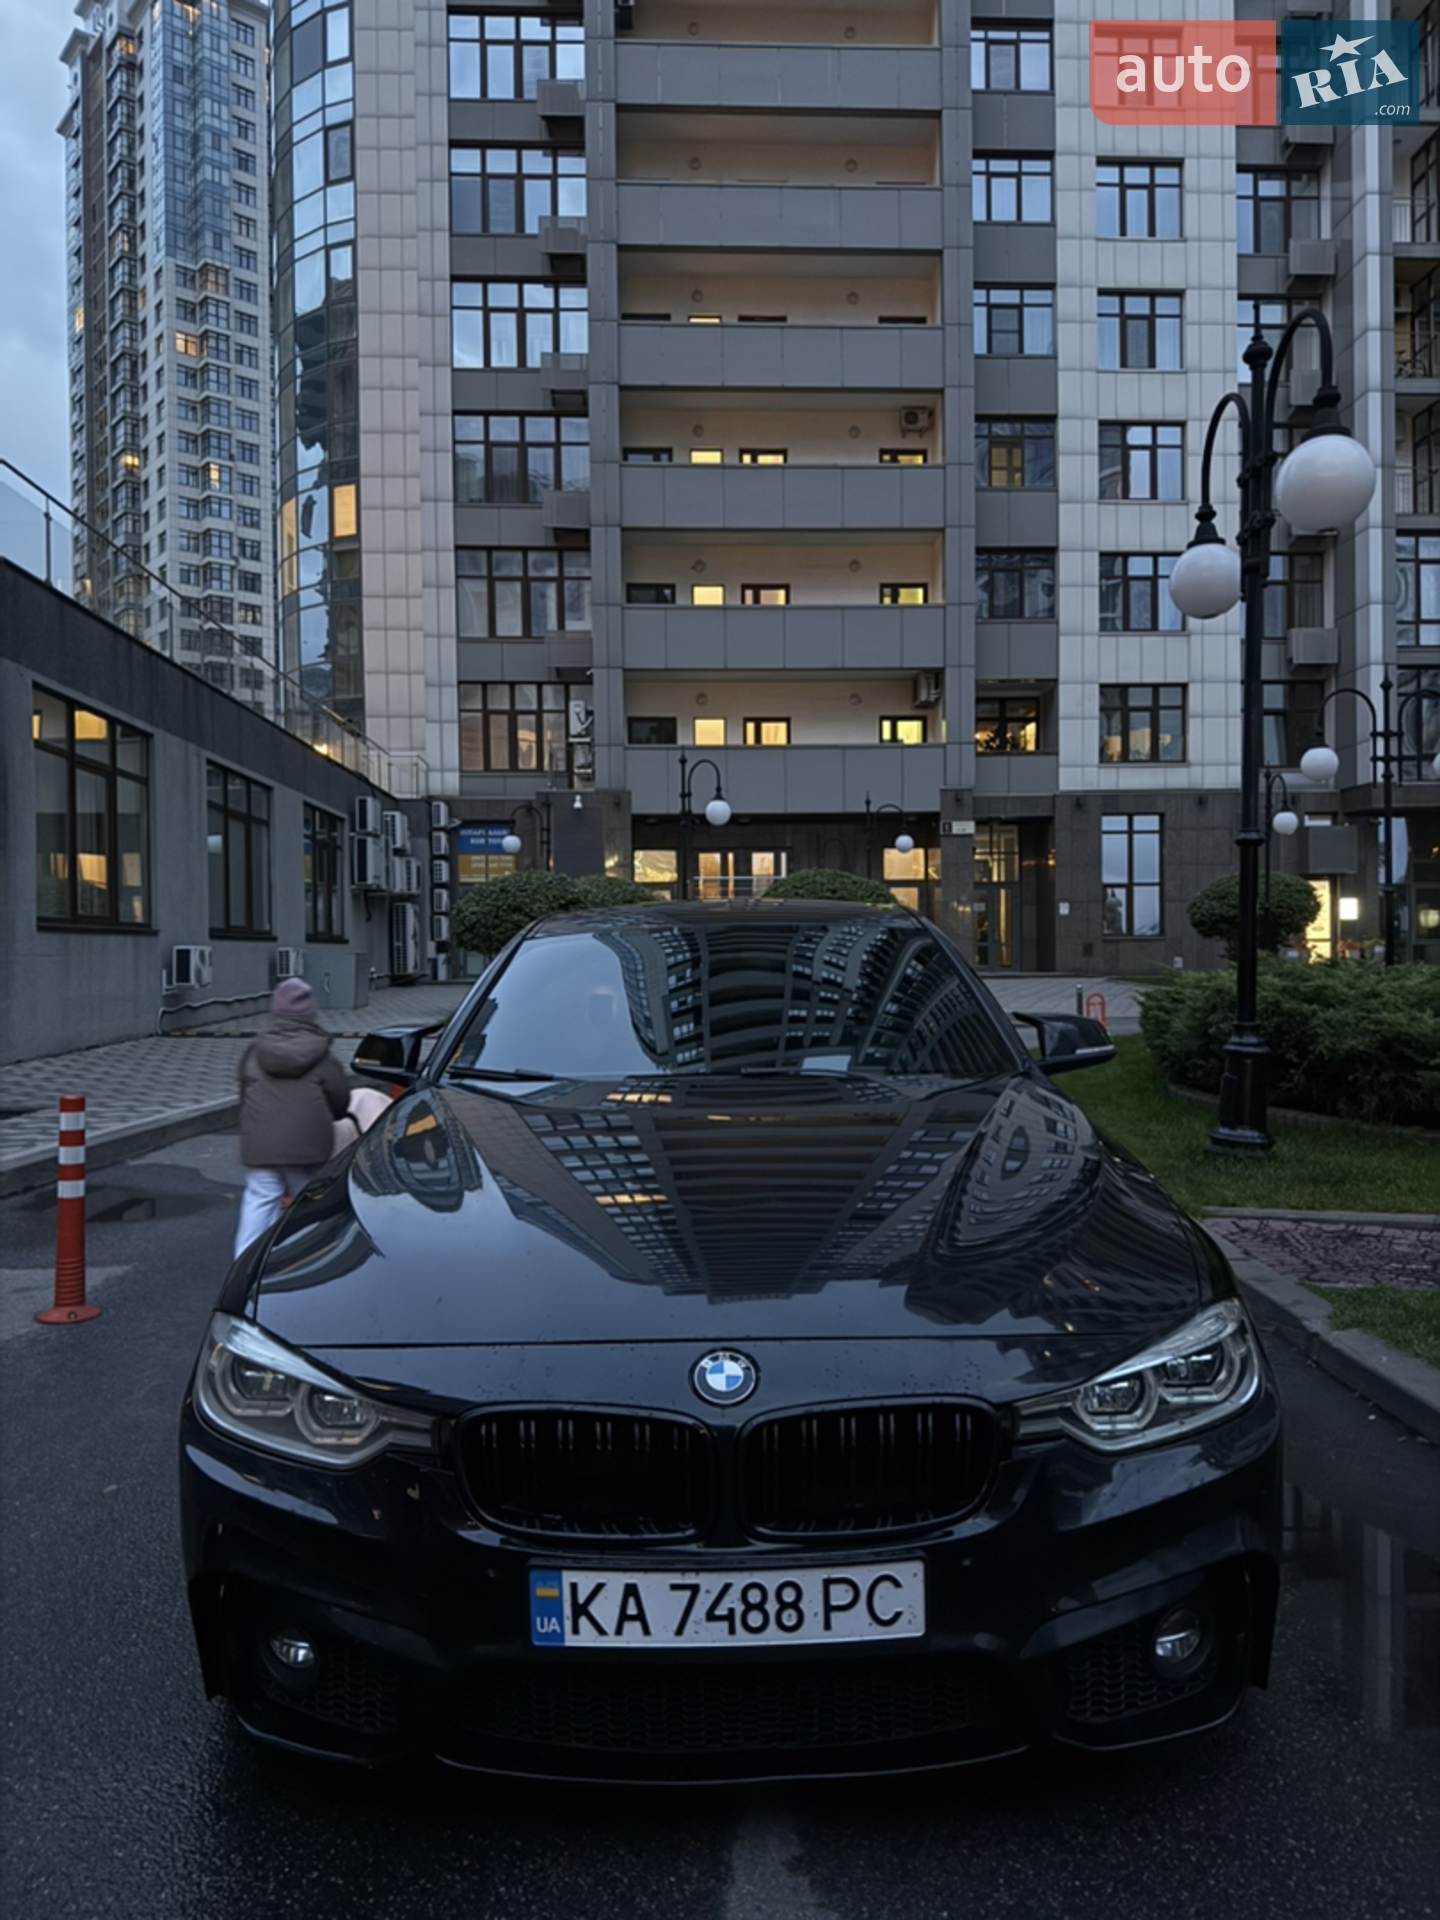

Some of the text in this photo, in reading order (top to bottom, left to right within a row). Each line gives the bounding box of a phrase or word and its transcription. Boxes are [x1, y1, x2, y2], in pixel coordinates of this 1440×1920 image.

[536, 1616, 561, 1633] UA
[569, 1573, 904, 1636] KA 7488 PC
